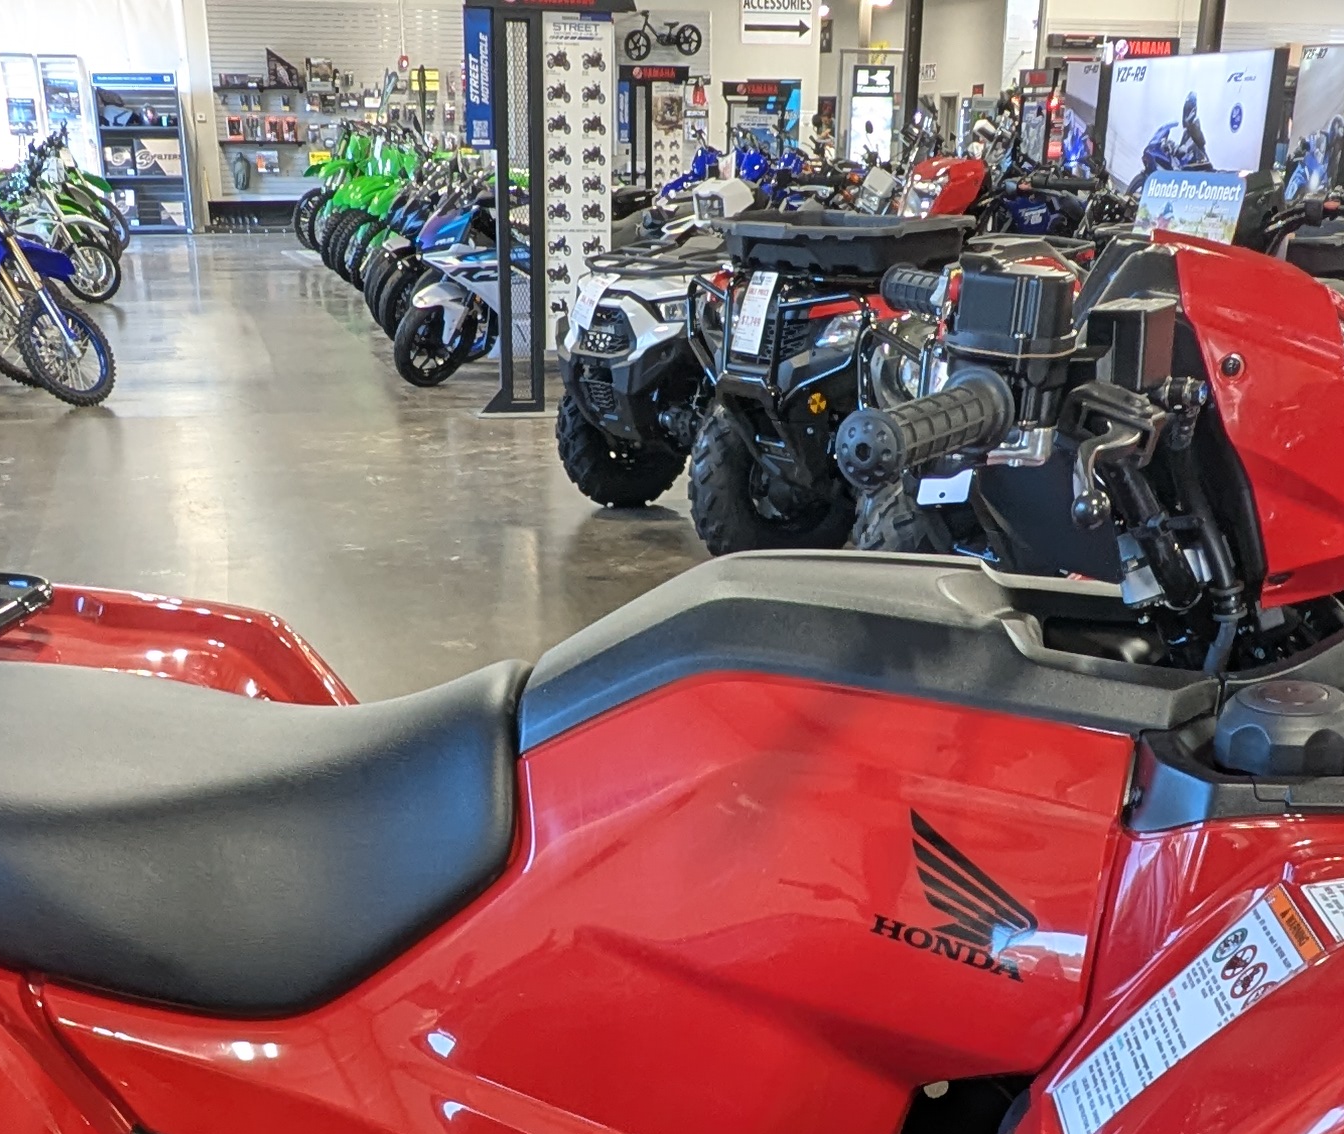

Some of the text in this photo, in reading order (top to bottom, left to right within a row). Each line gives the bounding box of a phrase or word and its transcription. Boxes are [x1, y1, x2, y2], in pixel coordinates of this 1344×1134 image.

[552, 22, 600, 33] STREET
[1127, 40, 1171, 55] YAMAHA
[468, 53, 481, 105] STREET
[479, 32, 490, 104] MOTORCYCLE
[1116, 66, 1147, 83] YZF-R9
[1147, 179, 1242, 201] Honda Pro-Connect
[870, 913, 1024, 983] HONDA
